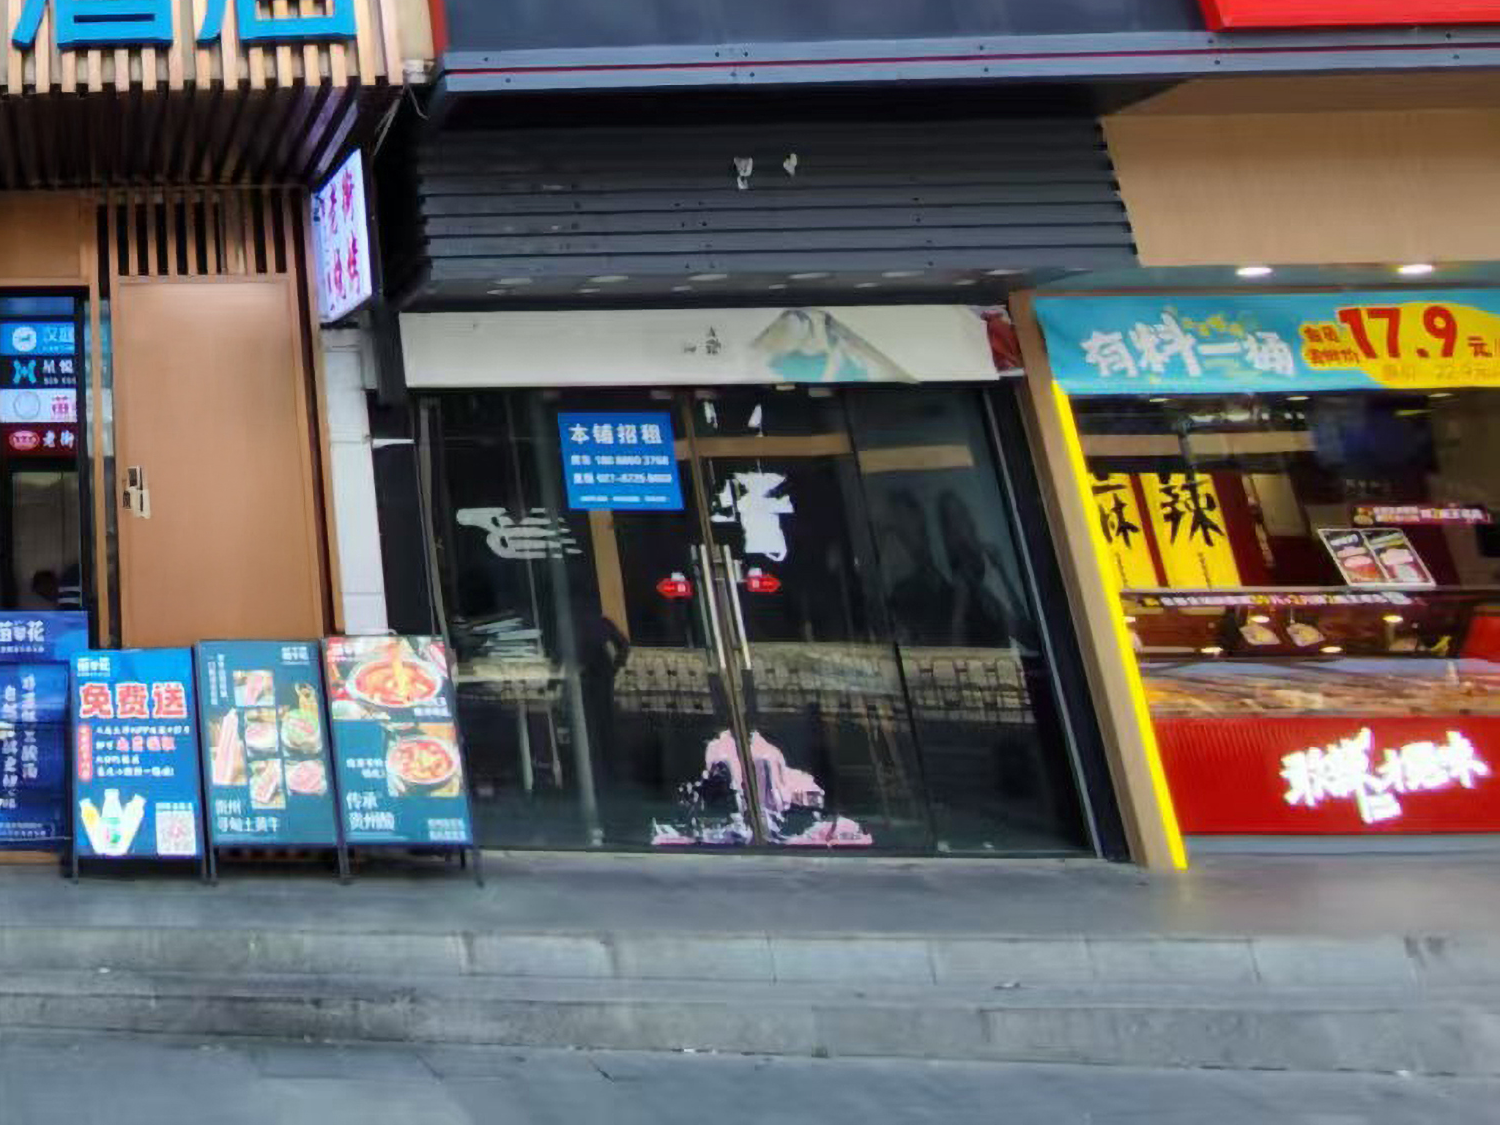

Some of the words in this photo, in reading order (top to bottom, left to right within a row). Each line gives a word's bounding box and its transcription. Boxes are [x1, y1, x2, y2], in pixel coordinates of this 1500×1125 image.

[1338, 306, 1458, 359] 17.9
[79, 682, 187, 719] 免费送
